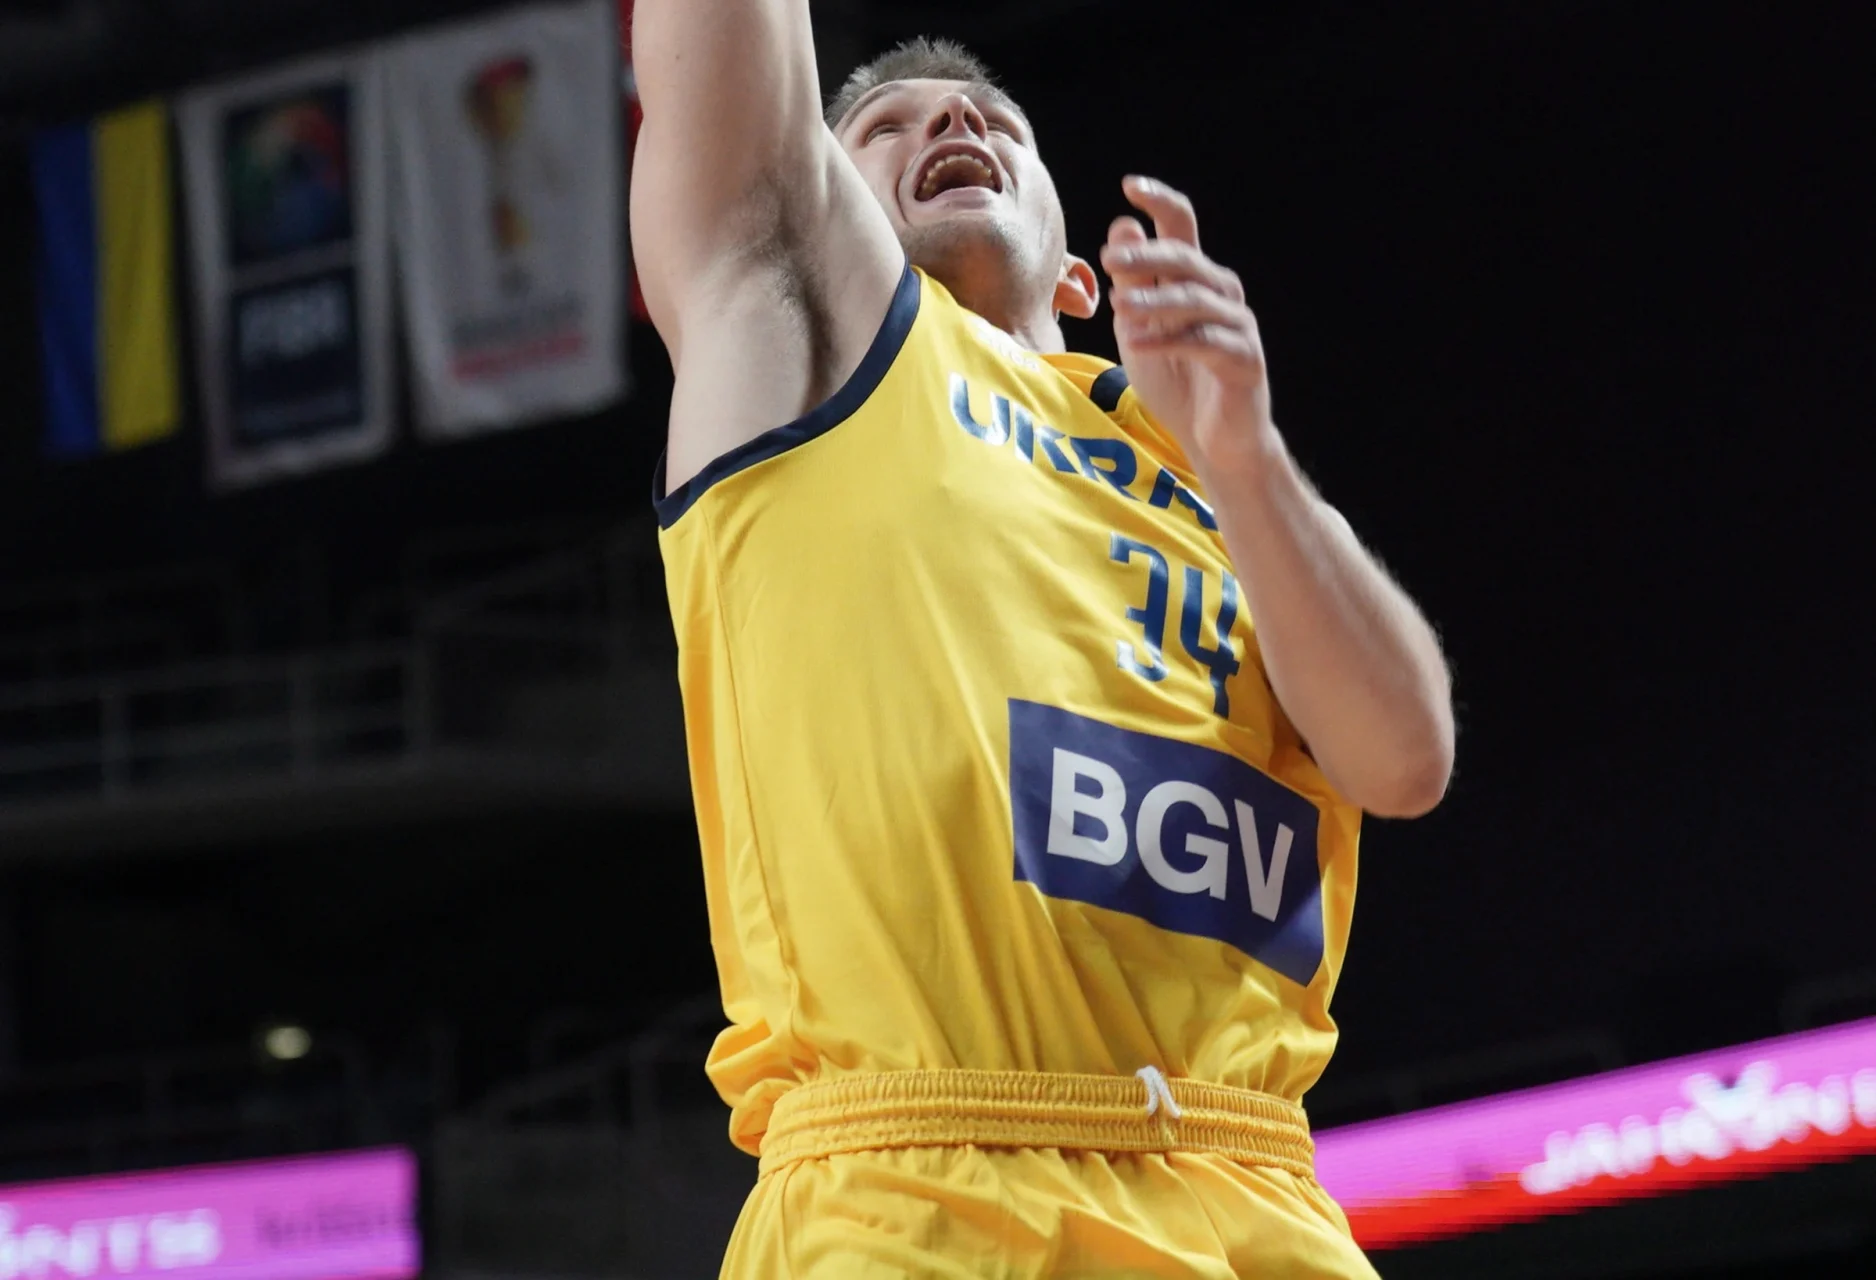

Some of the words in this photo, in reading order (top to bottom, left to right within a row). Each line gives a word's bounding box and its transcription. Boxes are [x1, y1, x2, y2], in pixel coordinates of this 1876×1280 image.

[950, 371, 1219, 531] UKRA
[1110, 532, 1239, 719] 34
[1047, 747, 1294, 922] BGV
